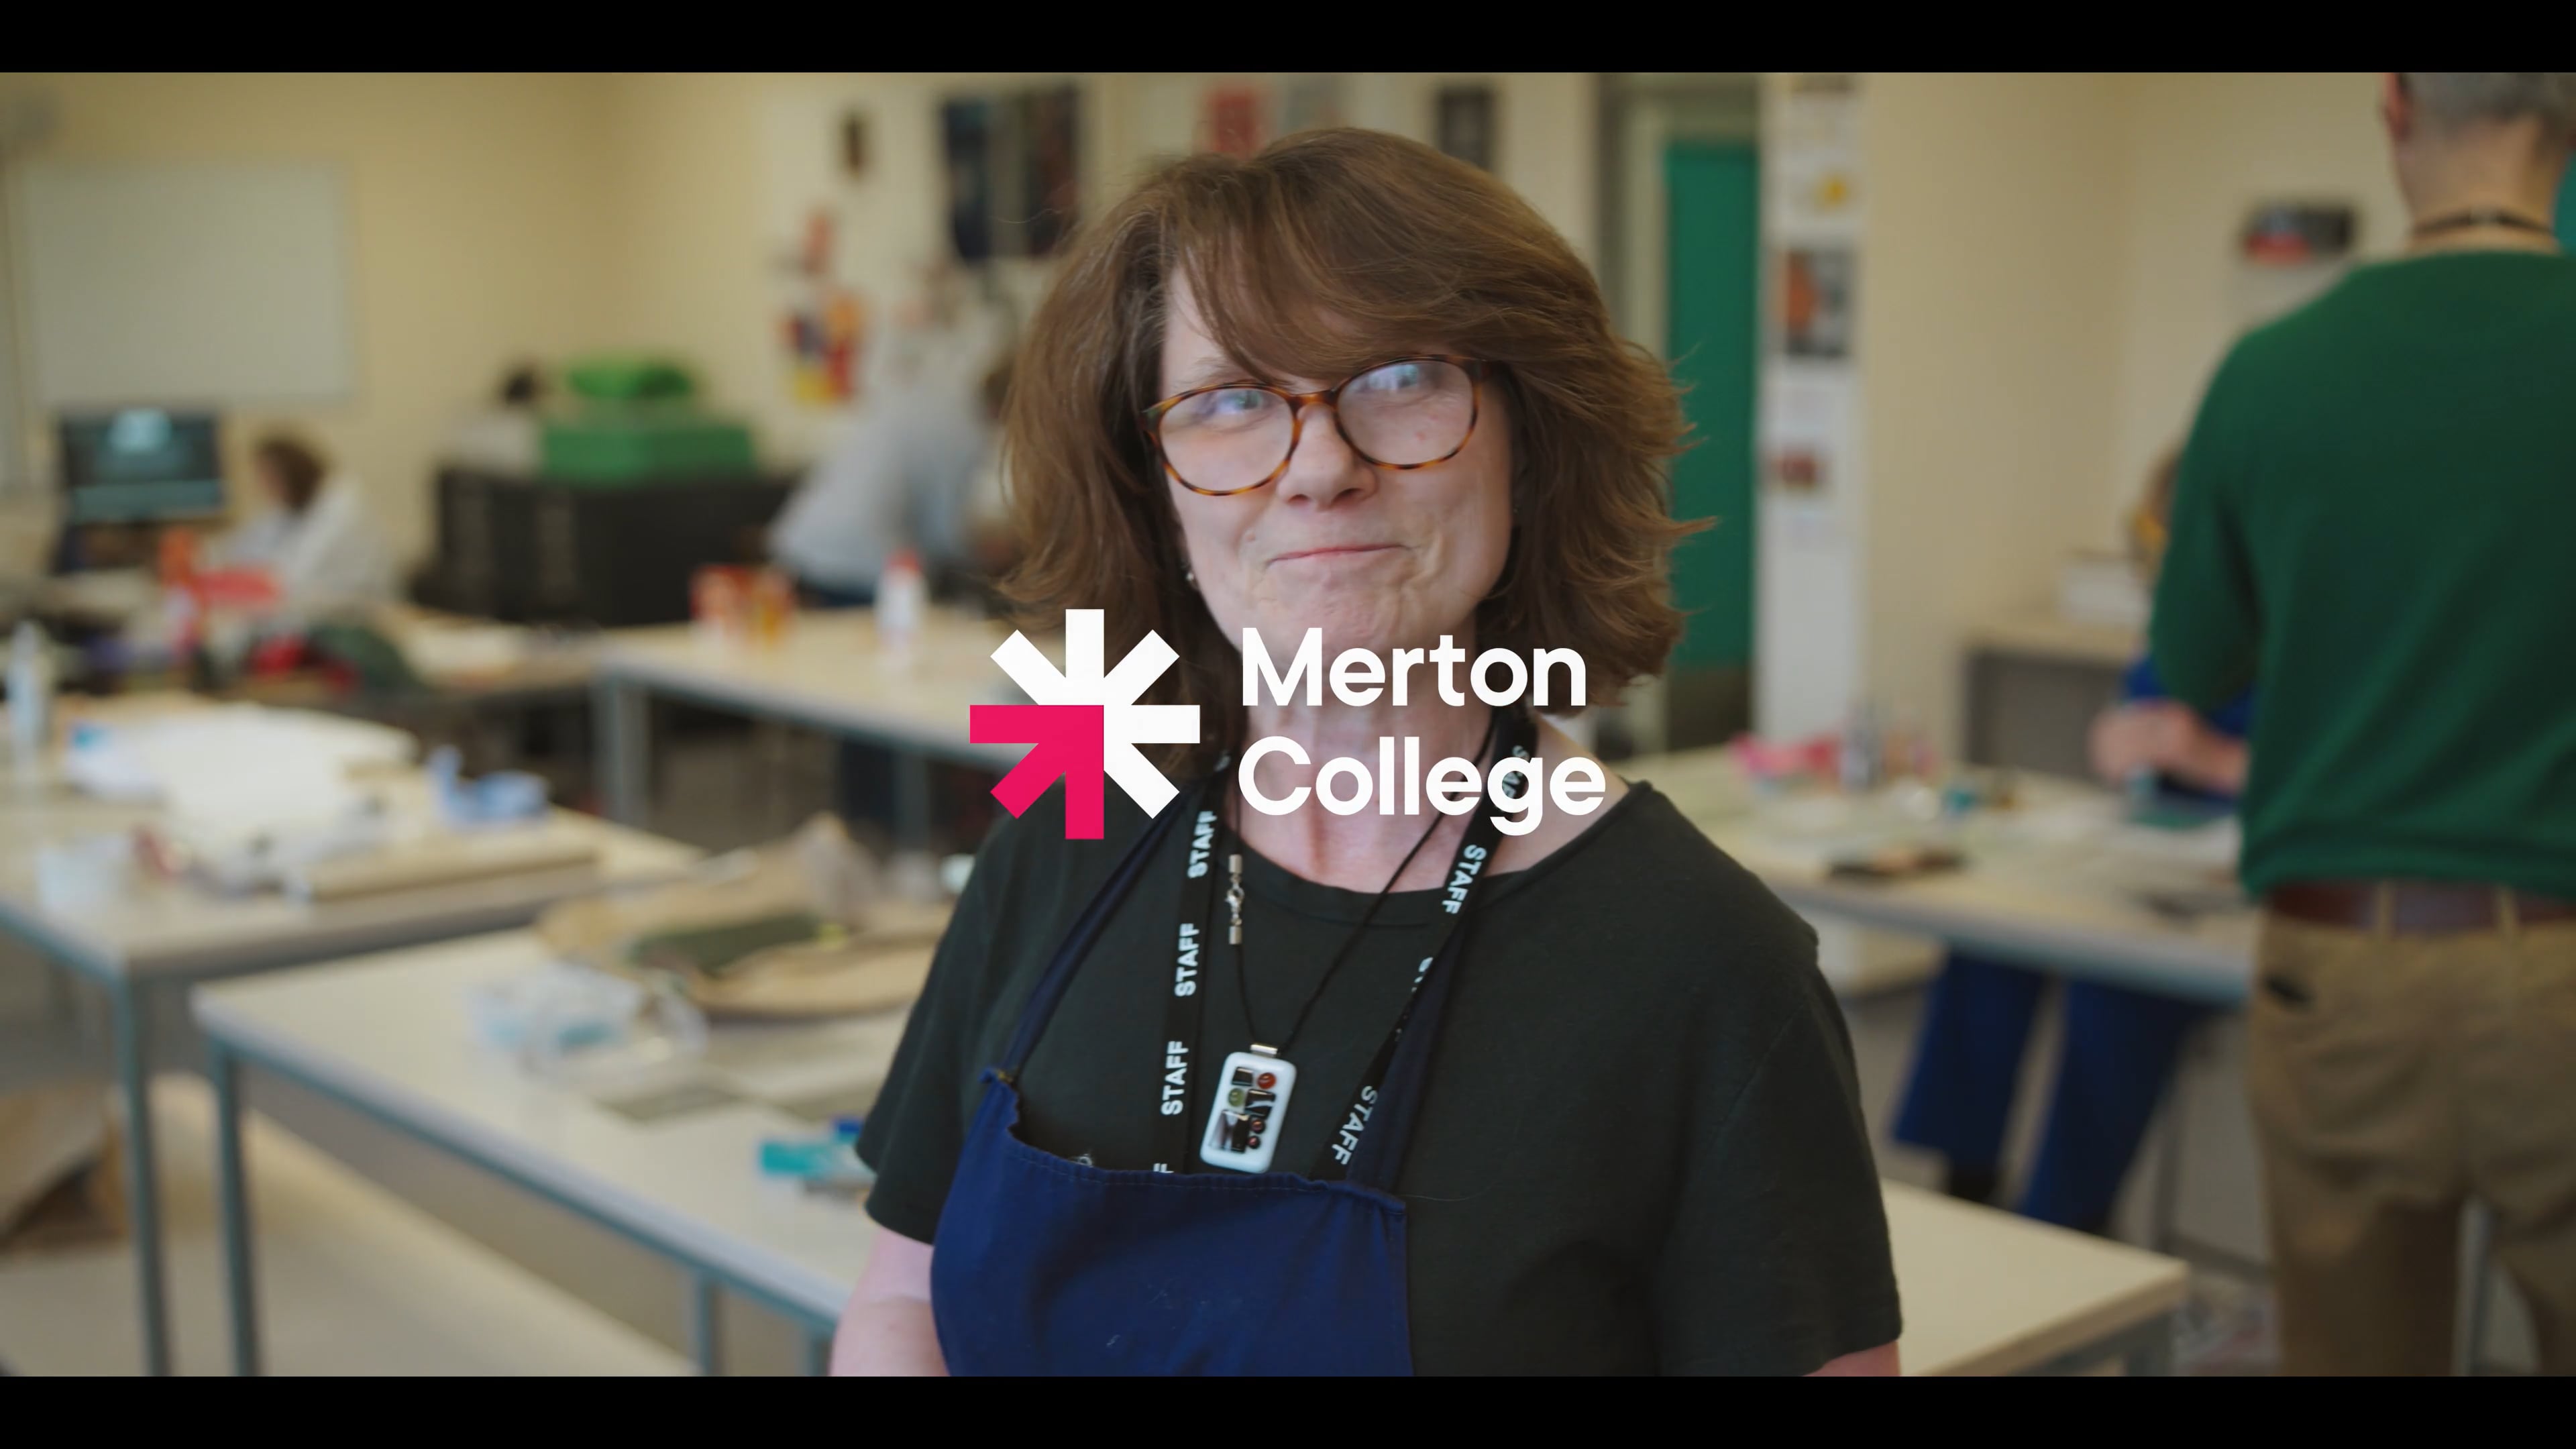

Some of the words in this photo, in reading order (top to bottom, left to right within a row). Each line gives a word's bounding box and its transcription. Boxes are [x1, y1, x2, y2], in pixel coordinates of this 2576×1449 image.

[1187, 810, 1218, 878] STAFF
[1442, 844, 1487, 914] STAFF
[1174, 923, 1200, 997] STAFF
[1161, 1040, 1189, 1116] STAFF
[1332, 1085, 1378, 1165] STAFF
